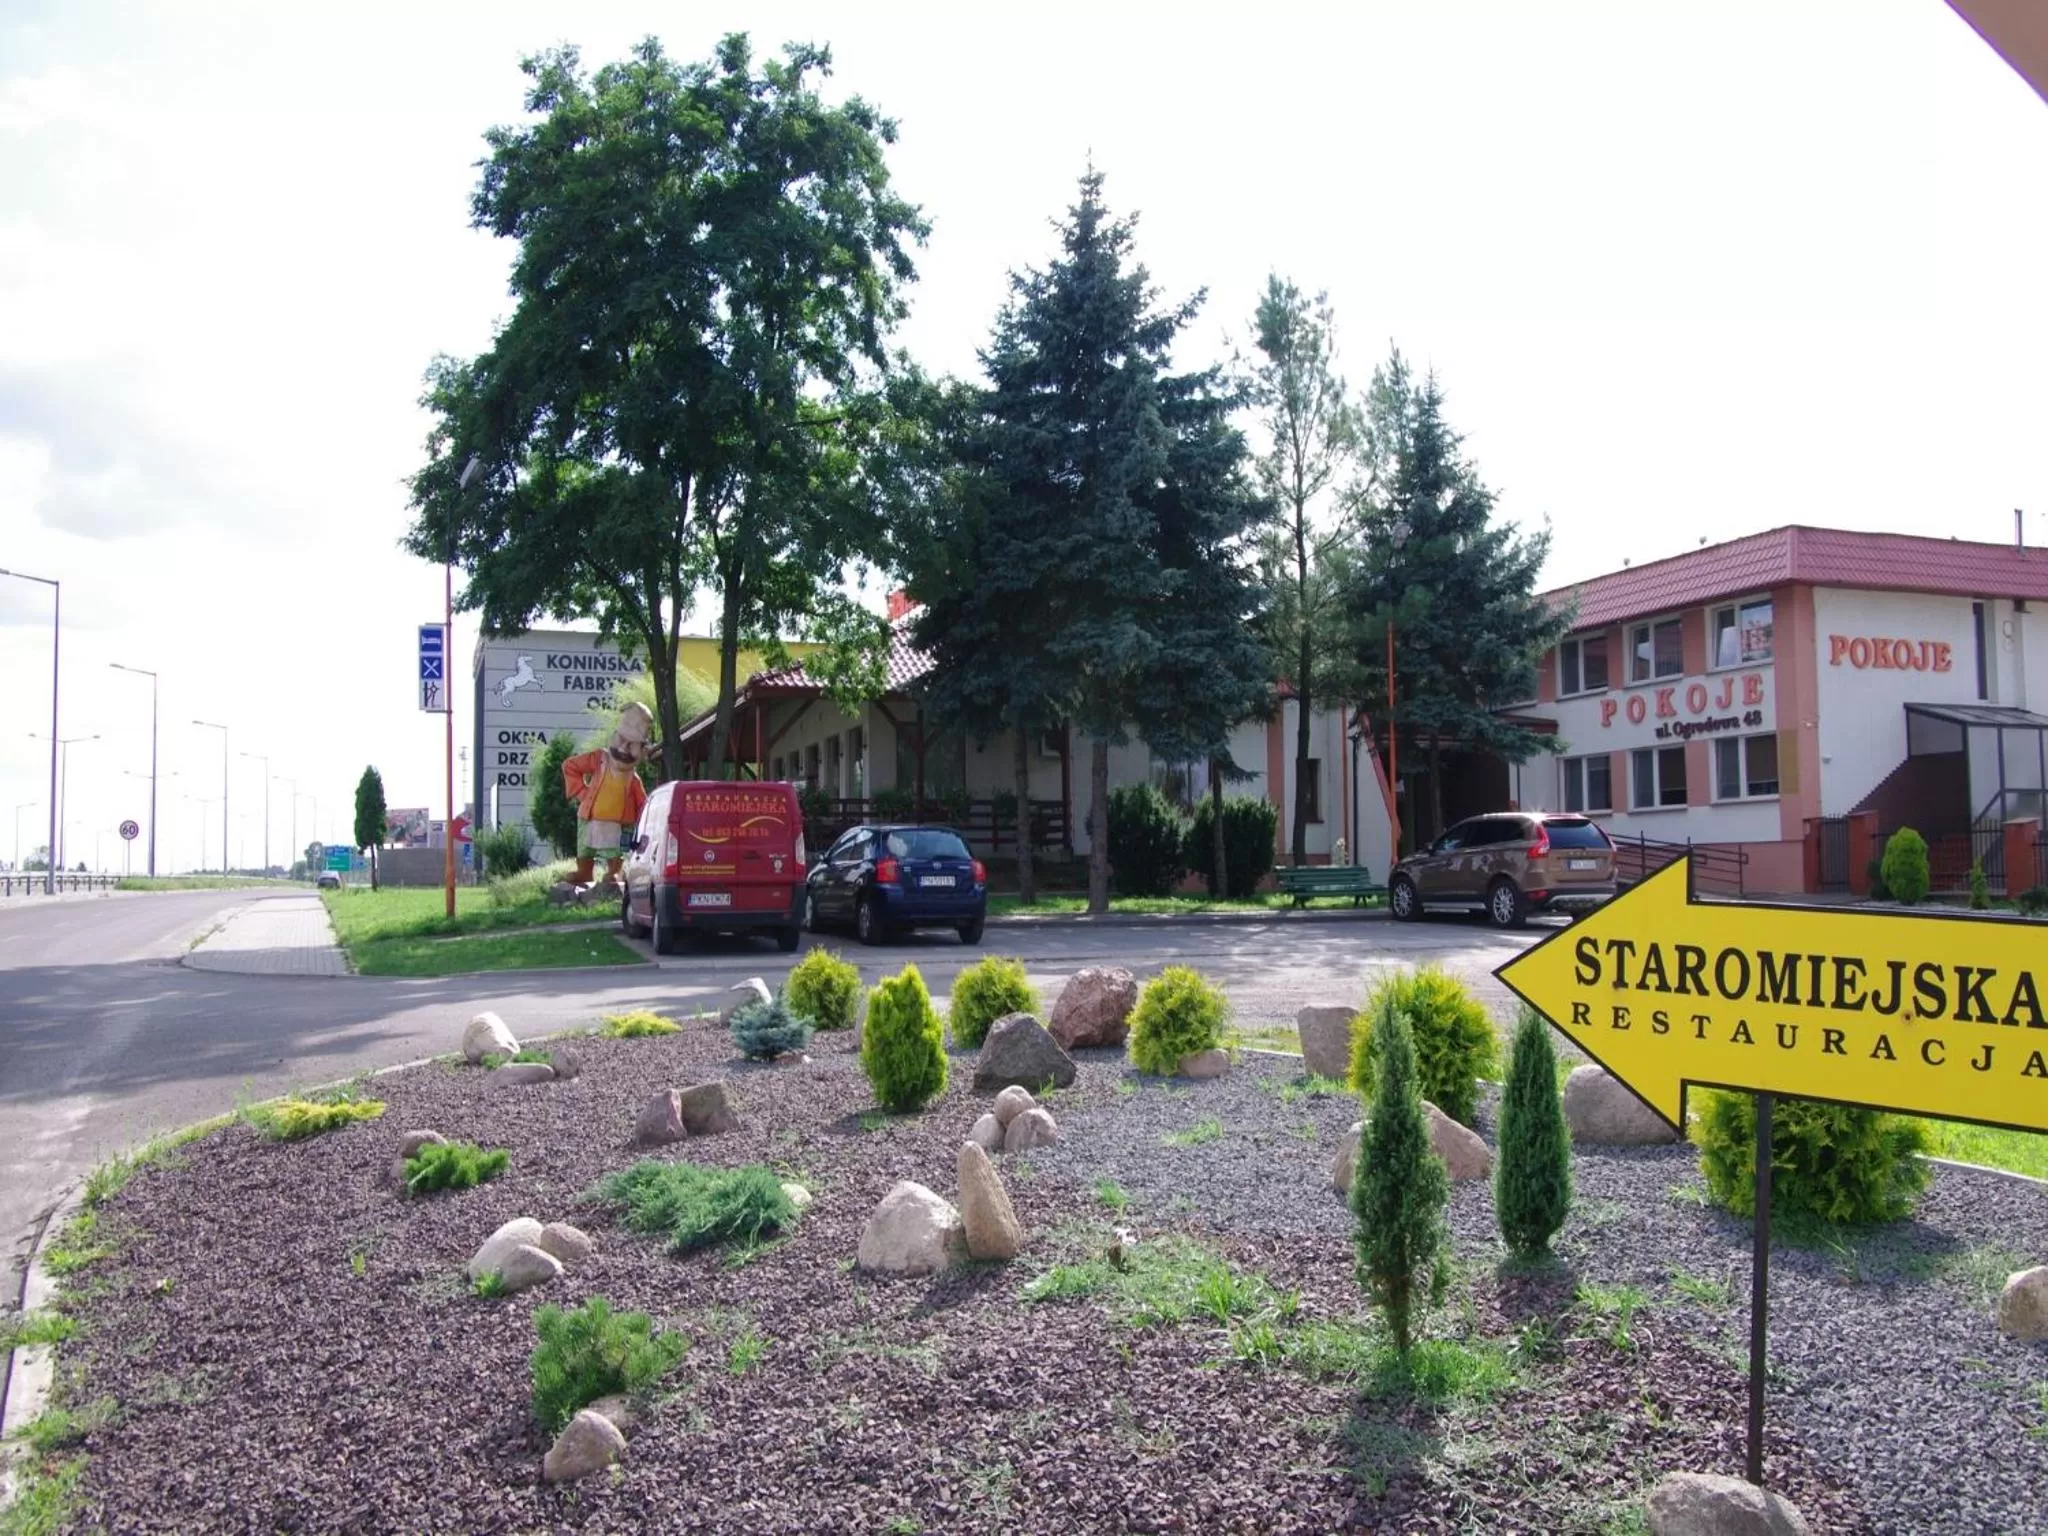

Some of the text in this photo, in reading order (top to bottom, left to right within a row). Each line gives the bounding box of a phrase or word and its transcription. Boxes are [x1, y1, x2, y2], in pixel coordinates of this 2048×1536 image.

[546, 652, 642, 672] KONIŃSKA
[1828, 633, 1953, 673] POKOJE
[1600, 673, 1765, 728] POKOJE
[1673, 715, 1741, 739] Ogrodowa
[1743, 709, 1763, 726] 48
[498, 751, 529, 765] DRZ
[498, 772, 528, 786] ROL
[122, 825, 136, 835] 60
[1574, 936, 2048, 1029] STAROMIEJSKA
[1571, 1001, 2048, 1078] RESTAURACJA
